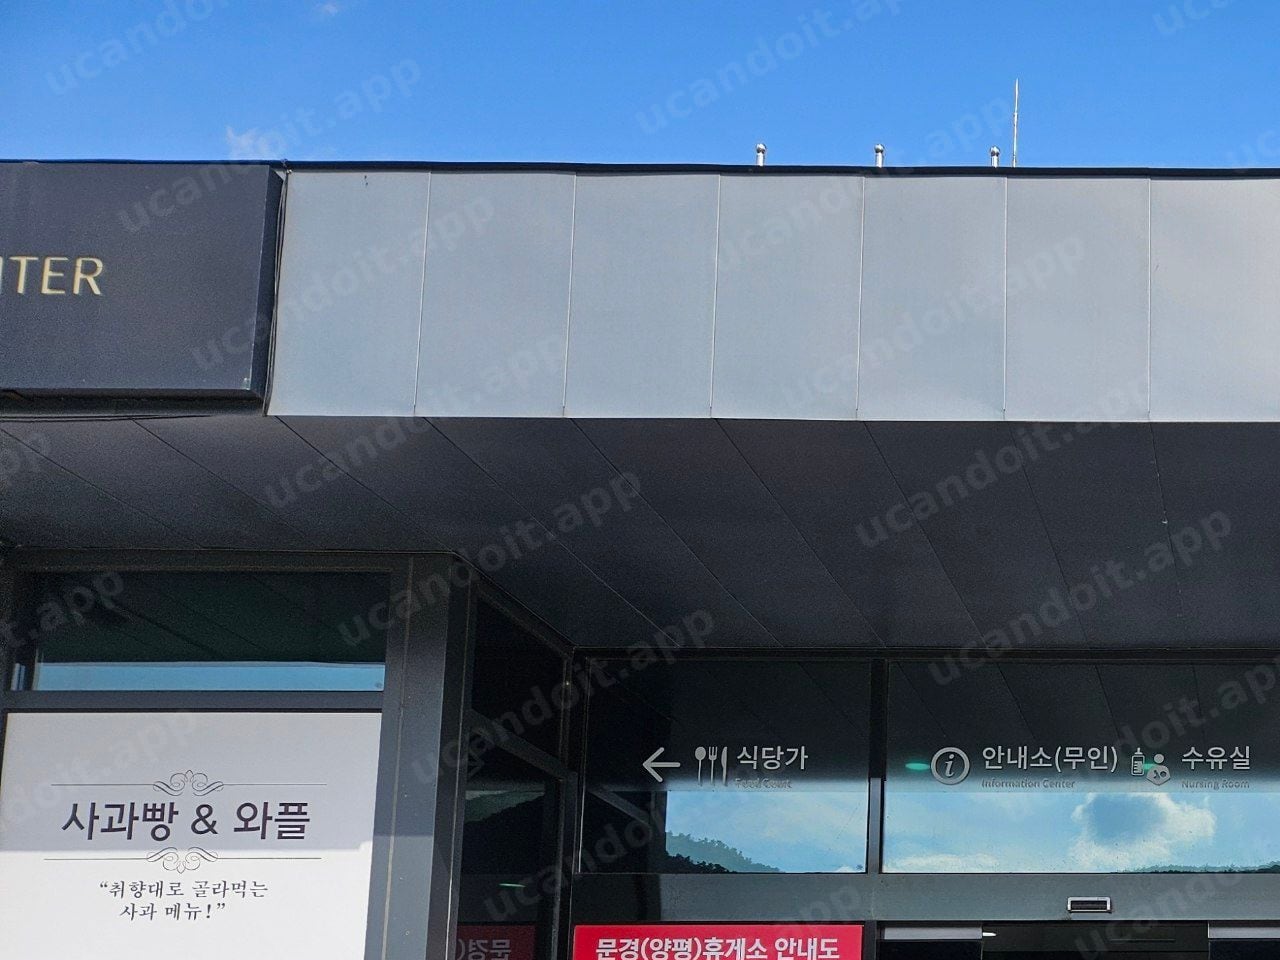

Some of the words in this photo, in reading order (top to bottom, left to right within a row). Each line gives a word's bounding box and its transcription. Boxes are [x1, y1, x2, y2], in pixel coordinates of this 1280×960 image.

[0, 256, 103, 295] TER
[736, 745, 808, 770] 식당가
[982, 745, 1118, 773] 안내소(무인)
[1181, 745, 1251, 771] 수유실
[734, 777, 760, 790] Food
[763, 777, 792, 790] Court
[981, 777, 1041, 789] Information
[1044, 777, 1076, 789] Center
[1181, 778, 1218, 792] Nursing
[1221, 778, 1250, 789] Room
[61, 801, 179, 842] 사과빵
[190, 803, 219, 835] &
[233, 801, 310, 840] 와플
[191, 879, 269, 898] 골라먹는
[119, 902, 158, 921] 사과
